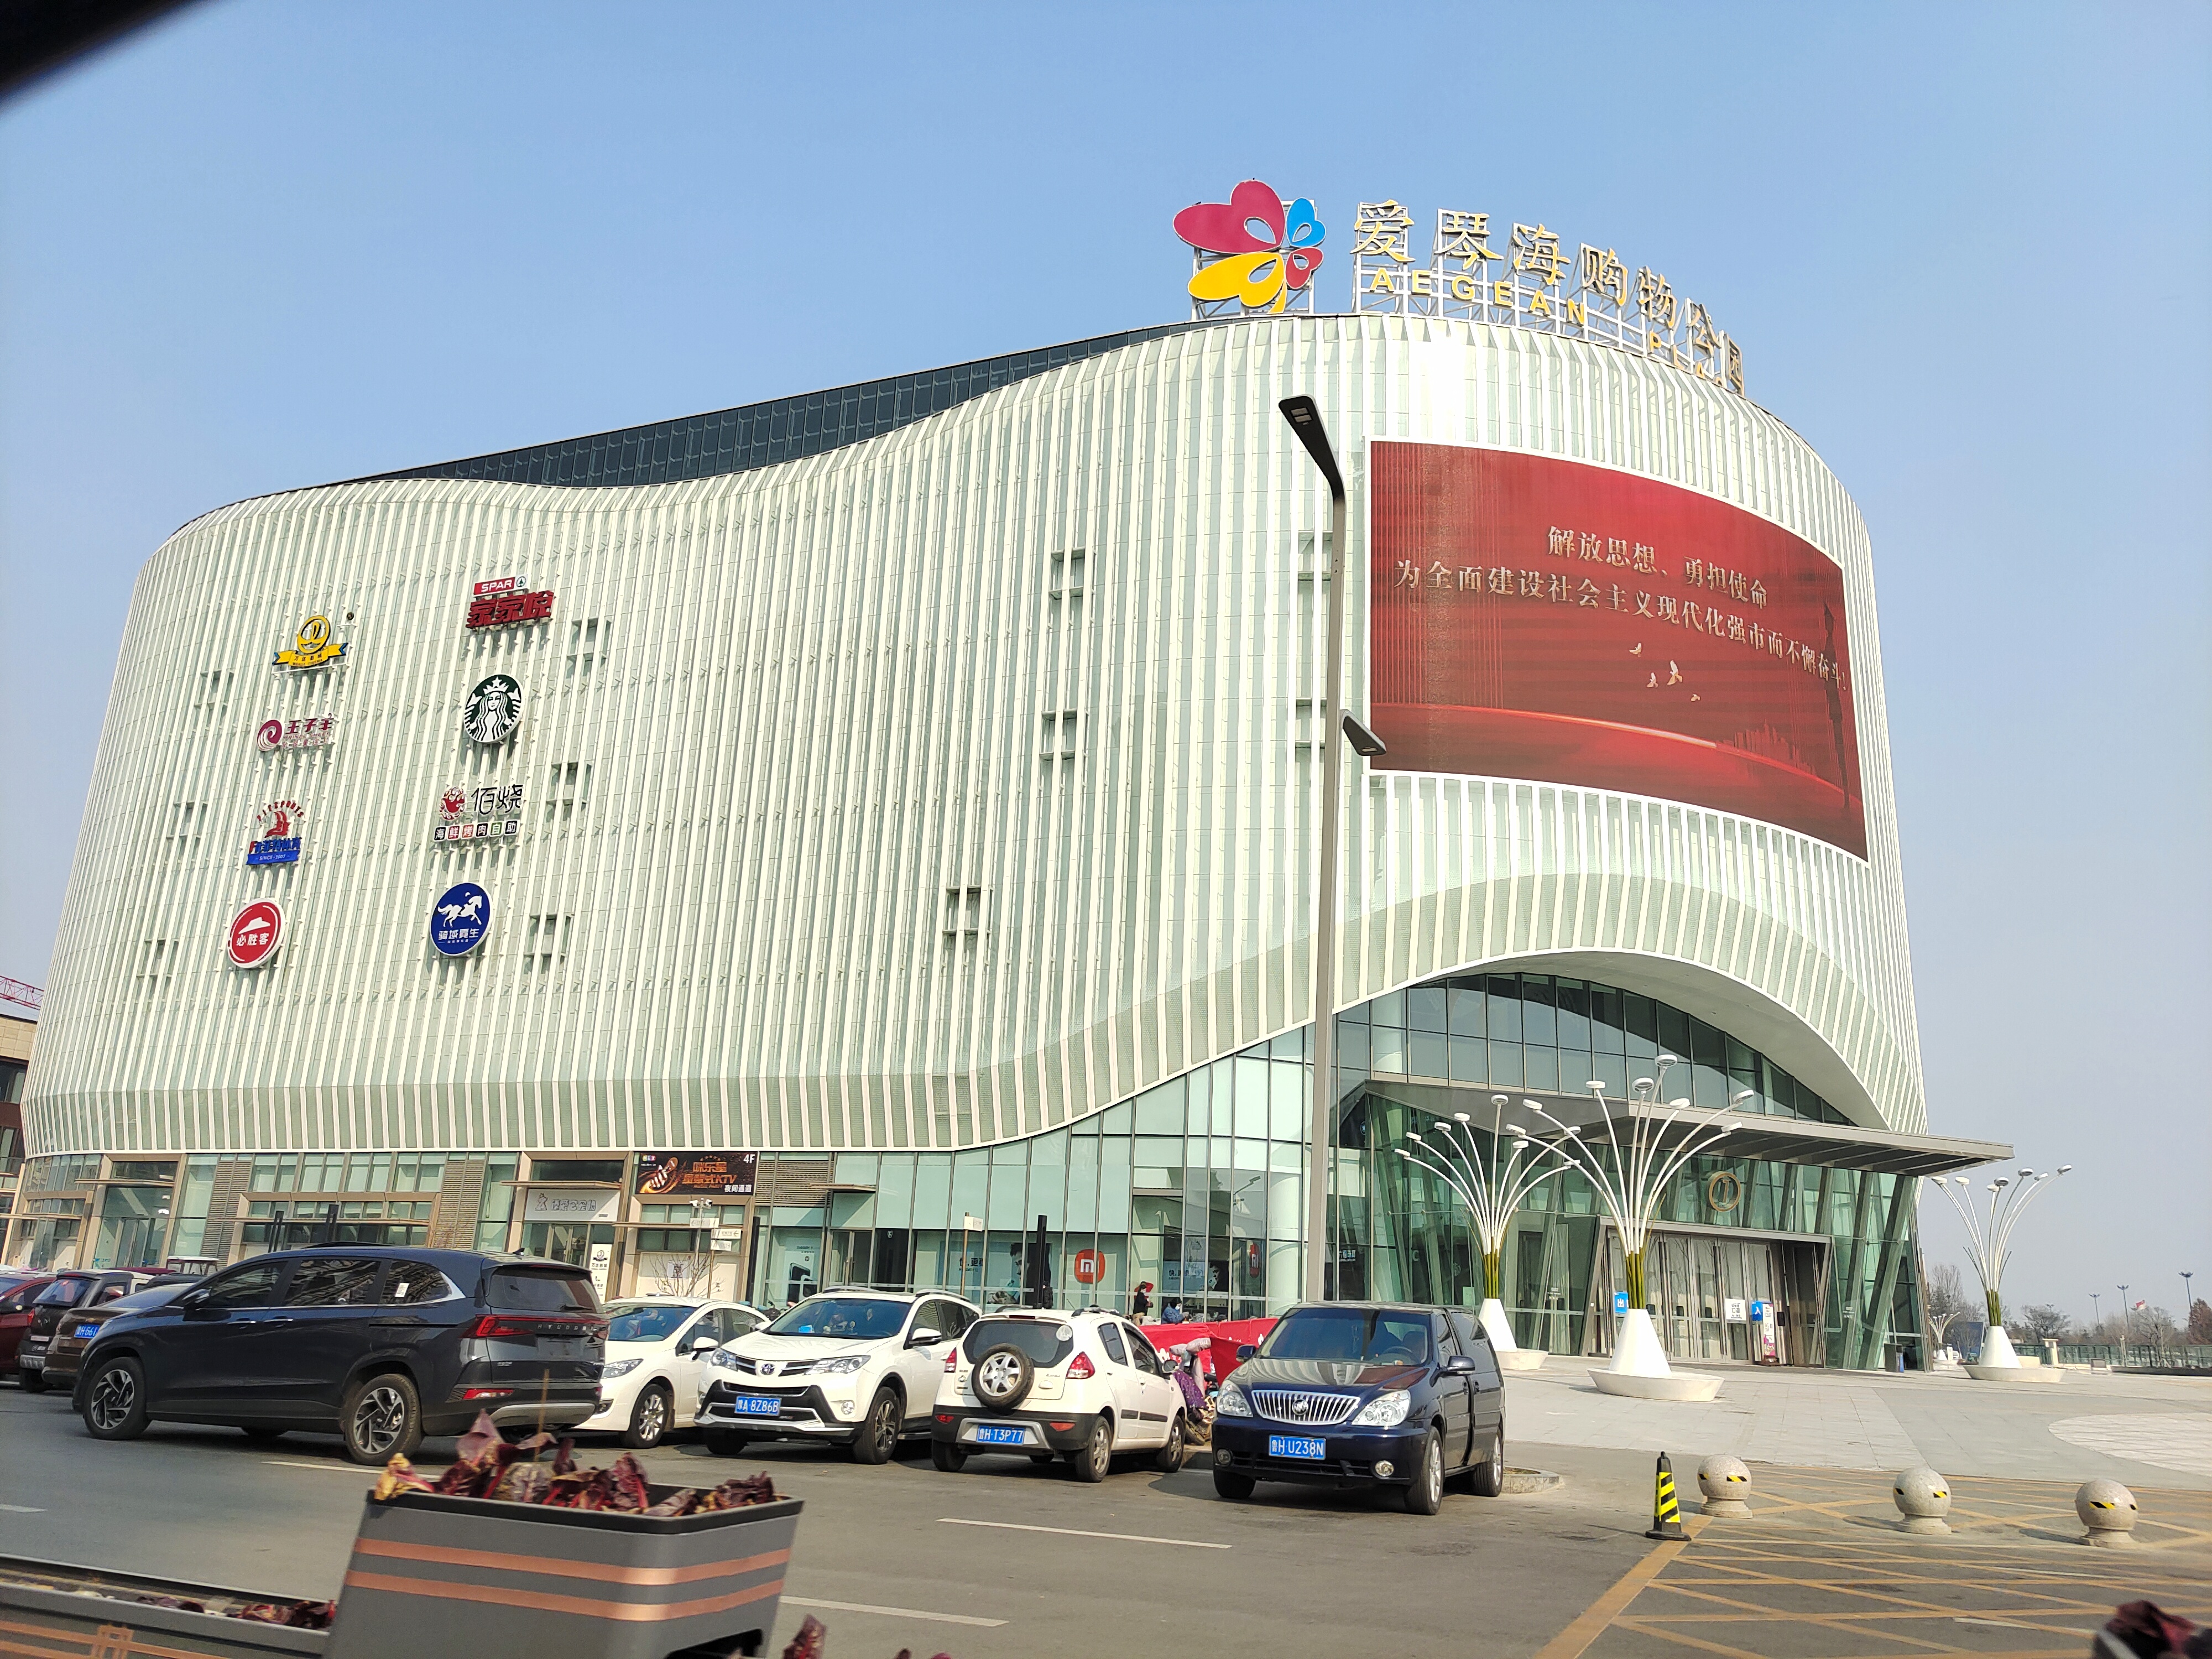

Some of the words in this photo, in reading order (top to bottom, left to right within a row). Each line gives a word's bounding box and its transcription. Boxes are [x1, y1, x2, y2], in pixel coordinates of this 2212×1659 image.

[1350, 199, 1745, 396] 爱琴海购物公园
[1370, 269, 1586, 326] AEGEAN
[481, 579, 513, 592] SPAR
[466, 591, 554, 629] 家家悦
[435, 820, 518, 840] 海鲜烤肉自助
[236, 932, 269, 947] 必胜客
[743, 1154, 755, 1164] 4F
[724, 1184, 752, 1193] 夜间通道
